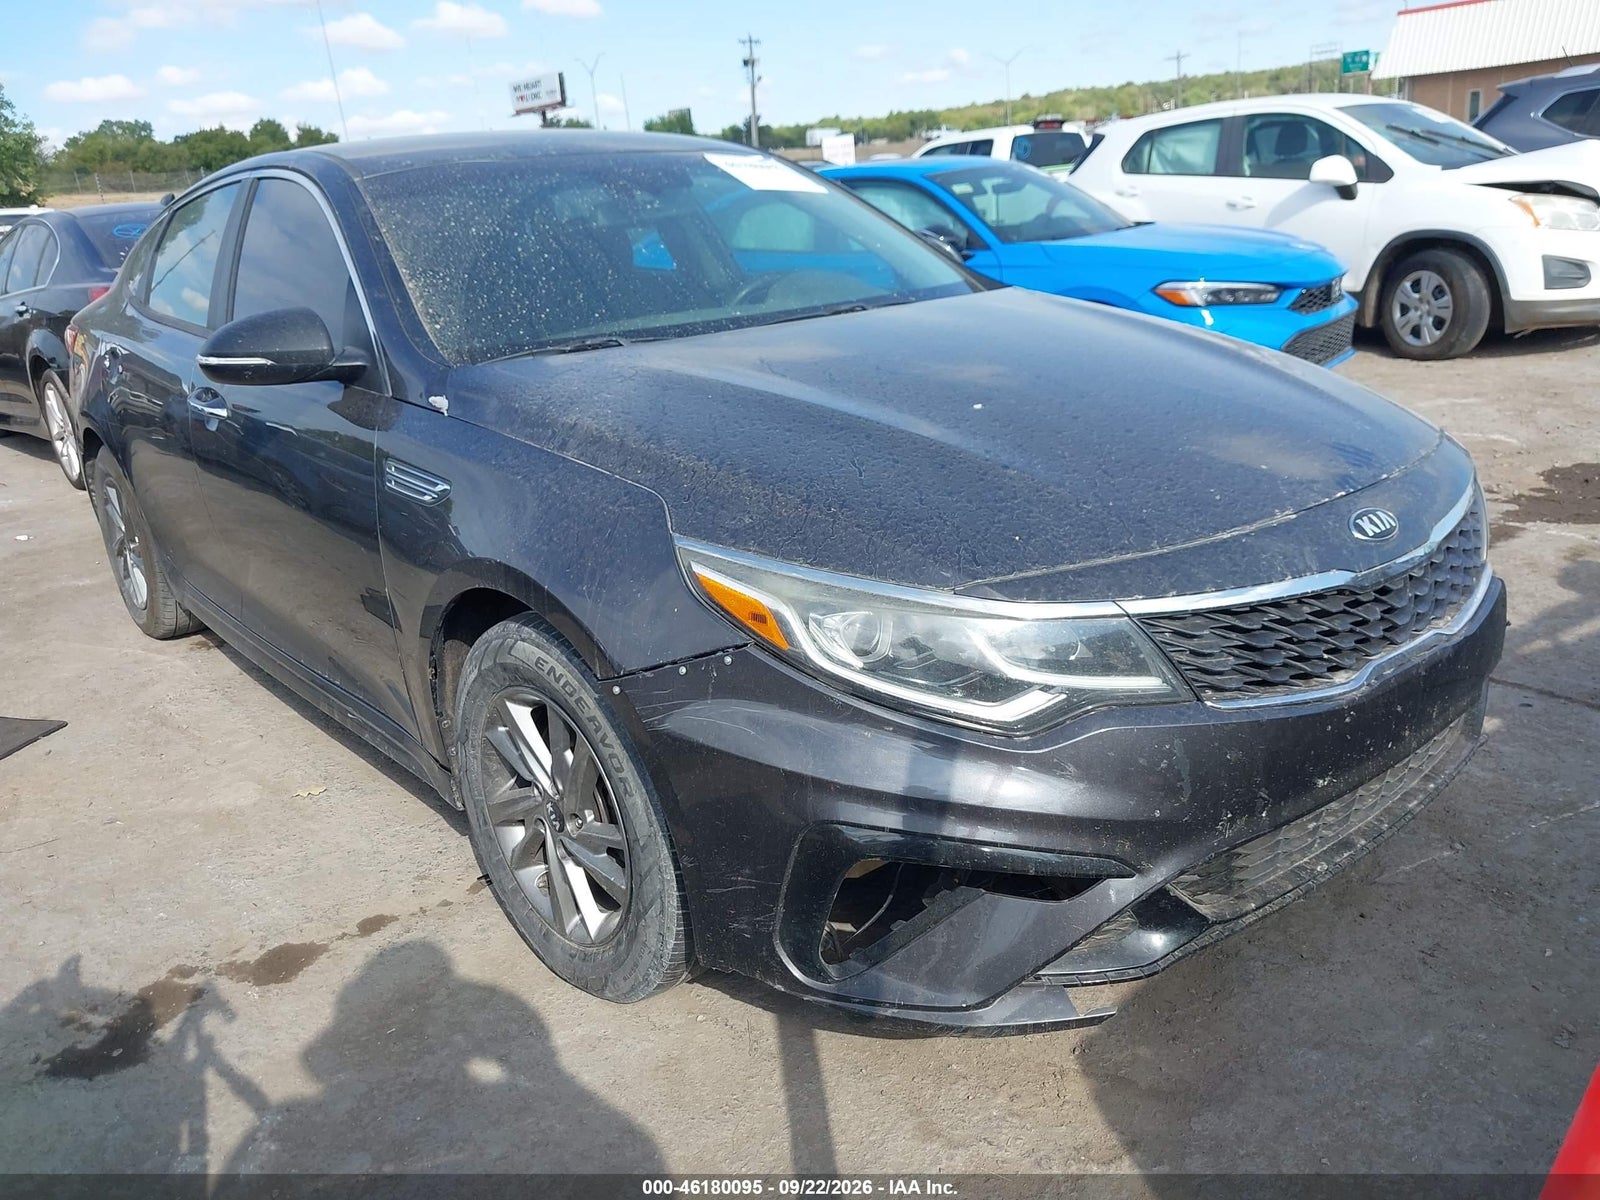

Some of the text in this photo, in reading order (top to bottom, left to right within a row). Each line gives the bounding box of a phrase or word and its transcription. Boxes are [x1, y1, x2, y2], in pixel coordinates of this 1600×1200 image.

[1355, 511, 1396, 537] KIA
[534, 656, 638, 798] ENDEAVOR
[546, 801, 560, 831] KIA
